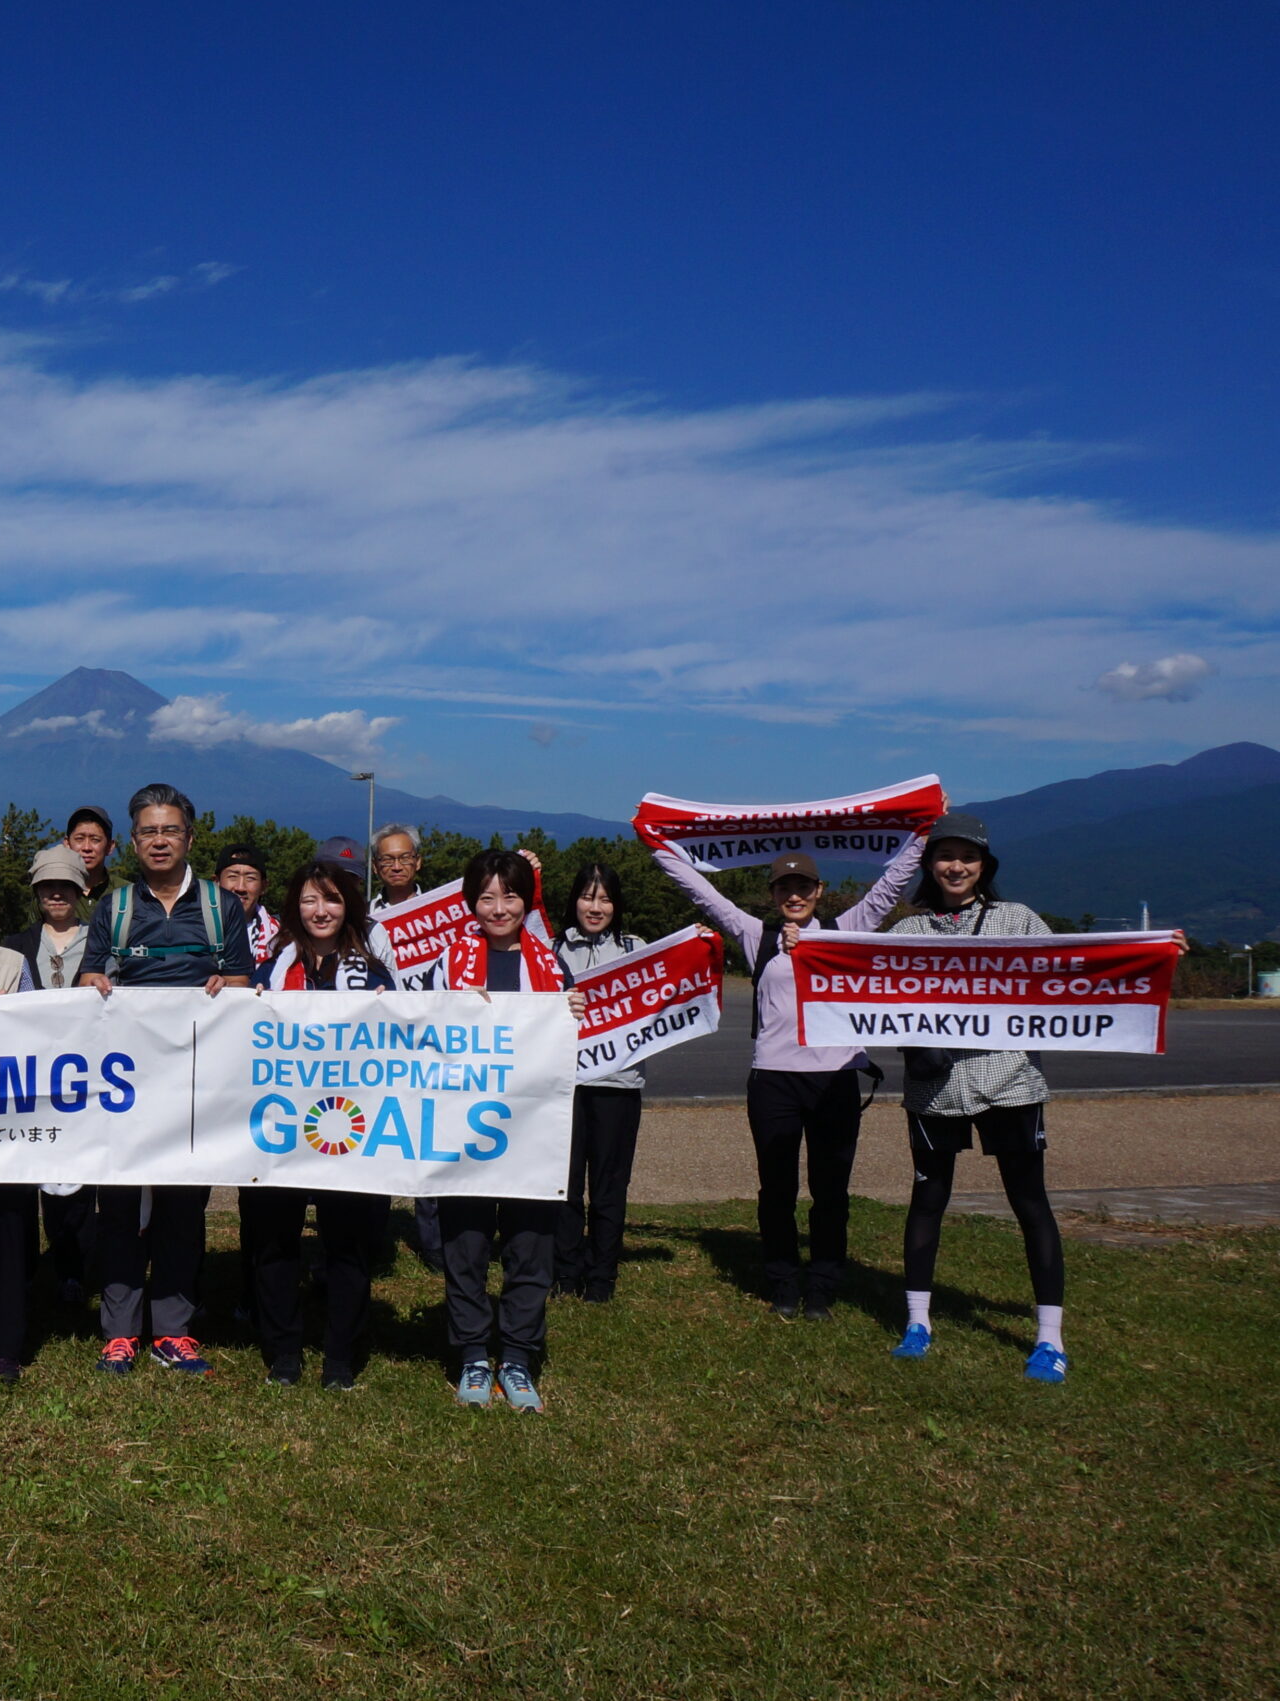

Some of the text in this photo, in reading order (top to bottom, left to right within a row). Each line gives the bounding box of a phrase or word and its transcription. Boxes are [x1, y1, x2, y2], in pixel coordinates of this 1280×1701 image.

[682, 834, 901, 864] WATAKYU GROUP
[871, 955, 1085, 973] SUSTAINABLE
[810, 973, 1152, 996] DEVELOPMENT GOALS
[252, 1020, 515, 1055] SUSTAINABLE
[626, 1005, 701, 1051] GROUP
[848, 1012, 1114, 1039] WATAKYU GROUP
[252, 1058, 515, 1093] DEVELOPMENT
[249, 1093, 513, 1163] GOALS
